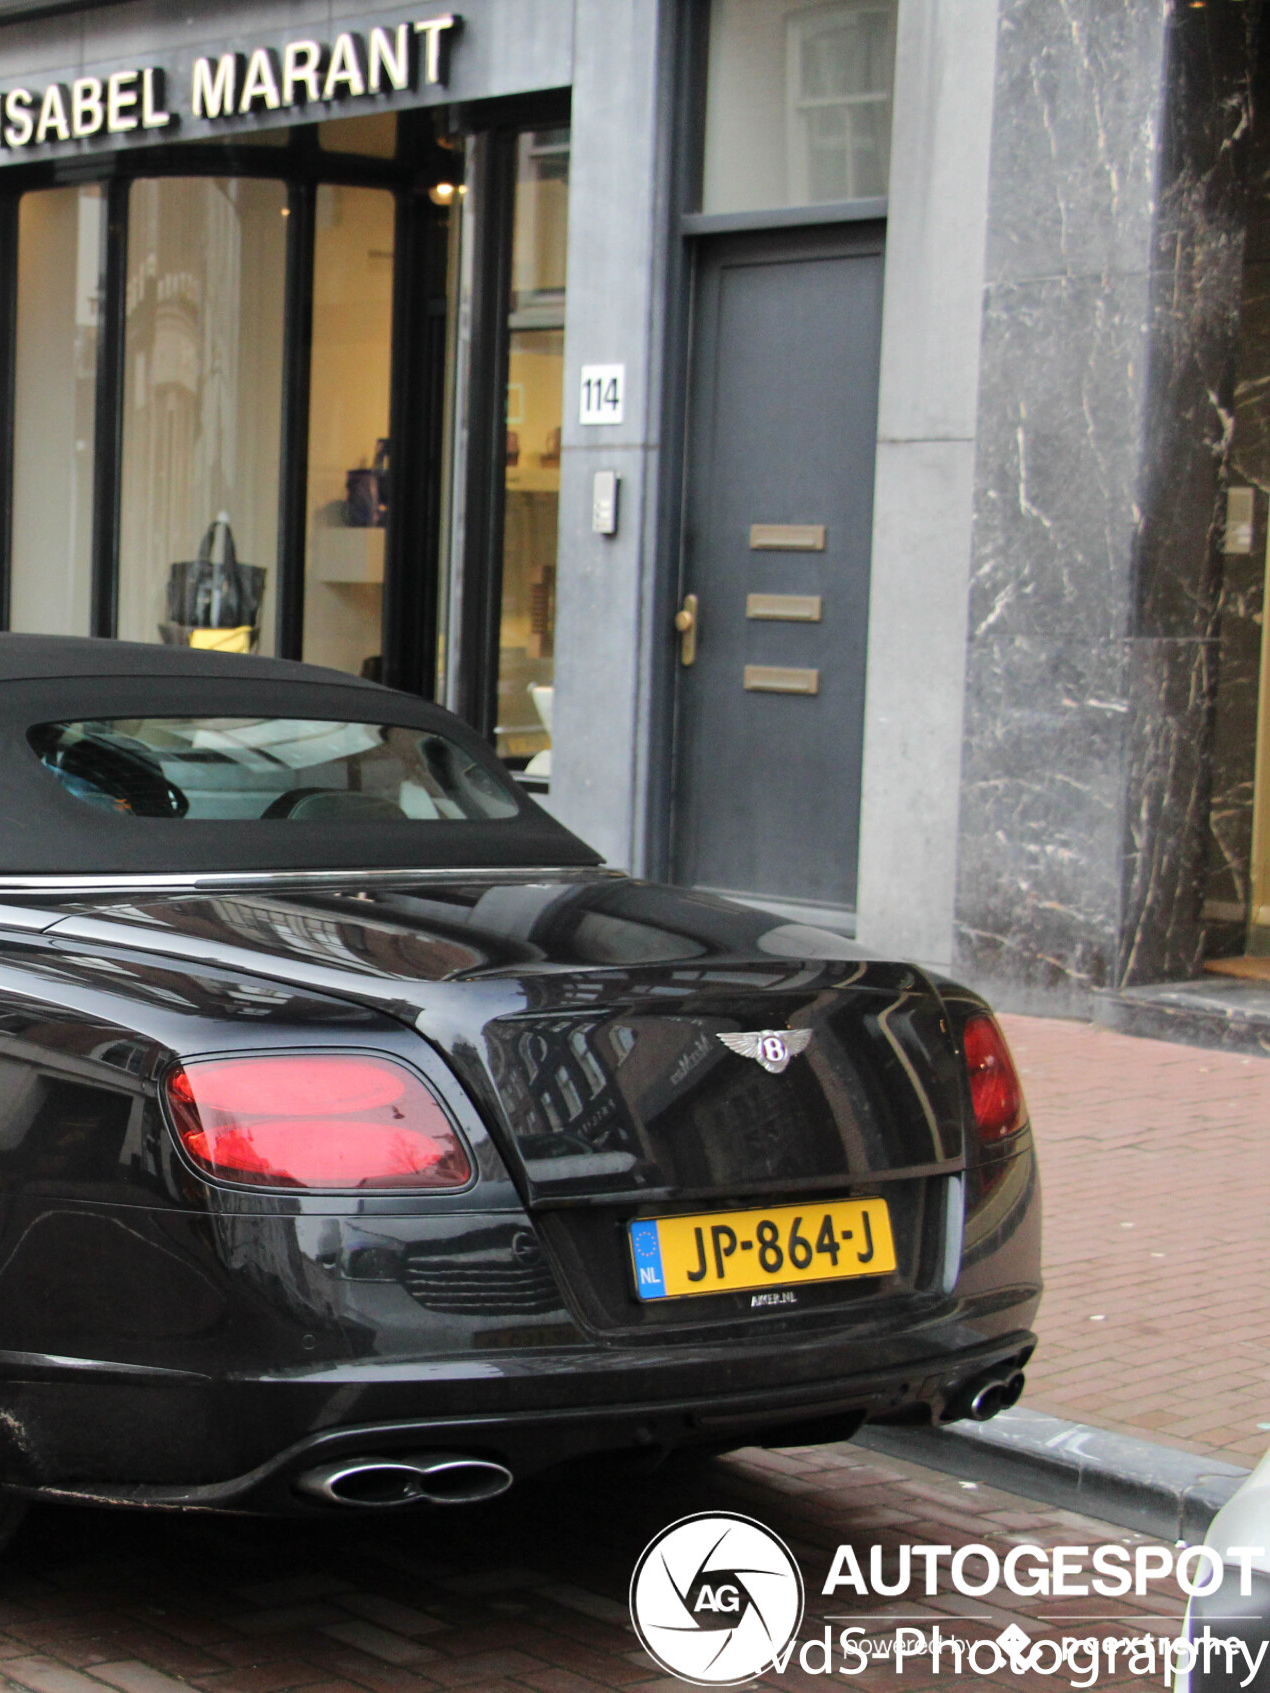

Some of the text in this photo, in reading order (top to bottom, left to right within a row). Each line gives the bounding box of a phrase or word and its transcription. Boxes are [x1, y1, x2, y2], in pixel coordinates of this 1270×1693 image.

[192, 14, 455, 119] MARANT
[582, 378, 619, 411] 114
[640, 1211, 874, 1285] NL JP-864-J
